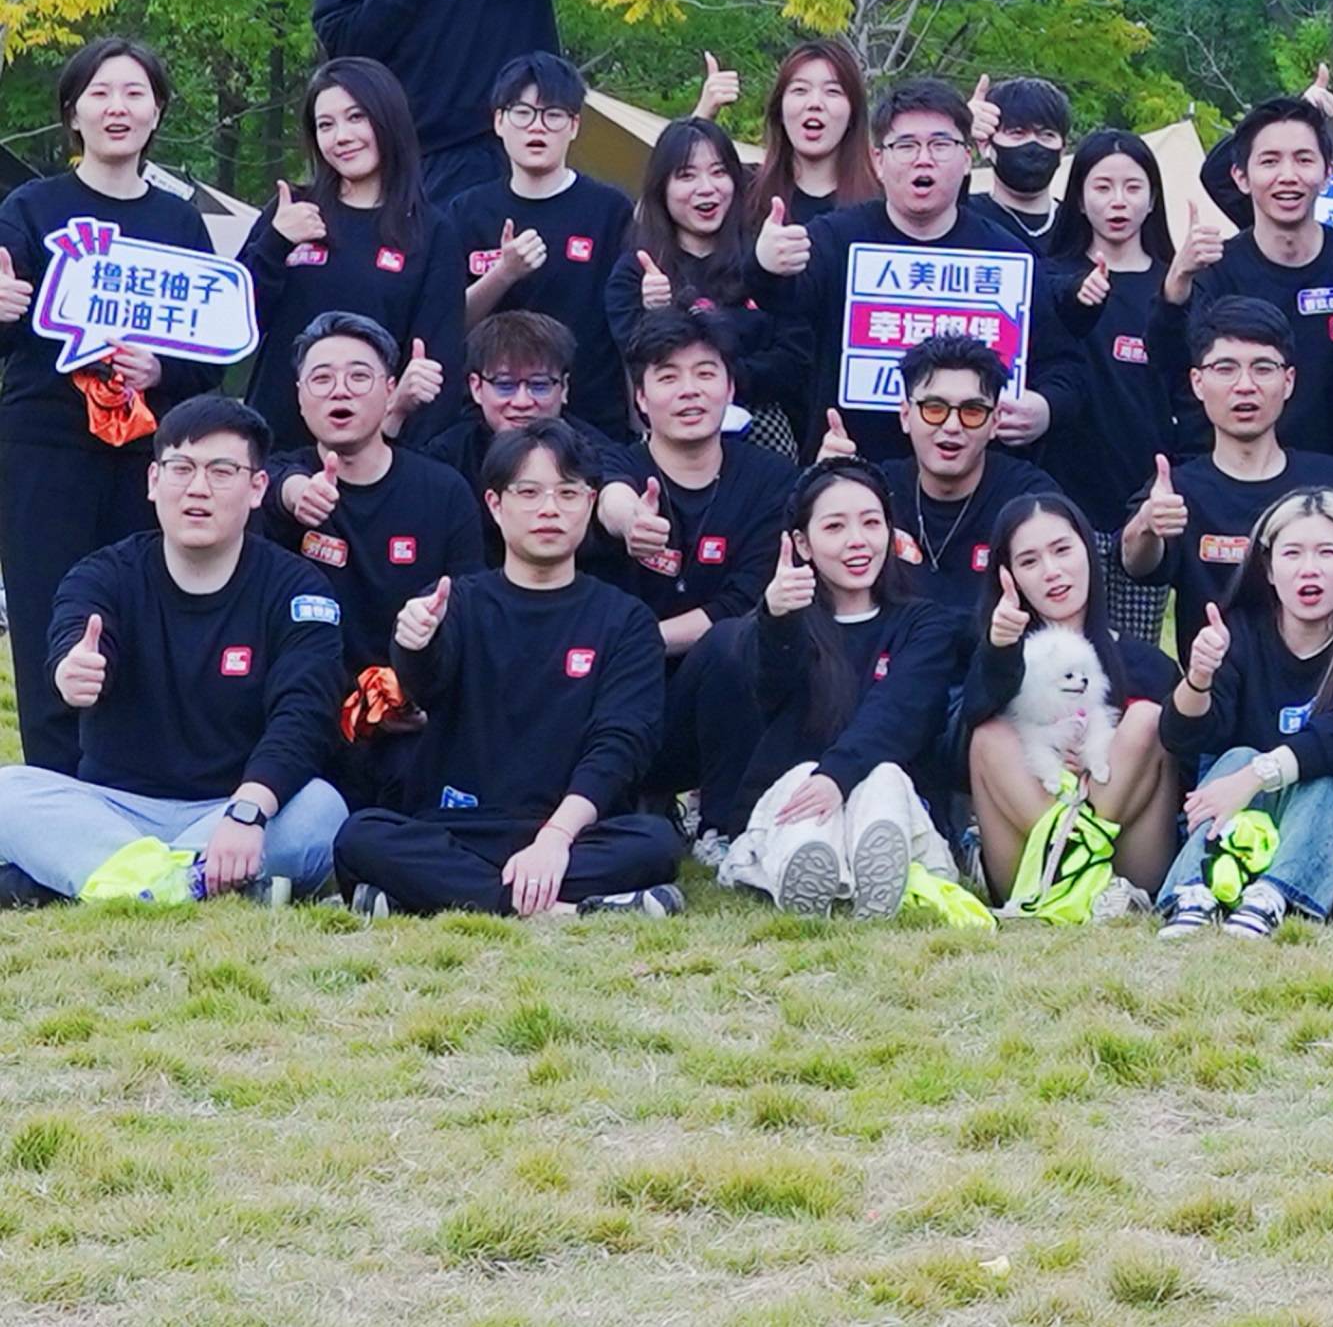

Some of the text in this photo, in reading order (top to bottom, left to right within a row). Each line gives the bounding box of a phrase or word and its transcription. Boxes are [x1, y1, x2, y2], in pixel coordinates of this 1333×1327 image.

[91, 260, 223, 305] 撸起袖子
[876, 259, 1003, 295] 人美心善
[86, 294, 199, 337] 加油干!
